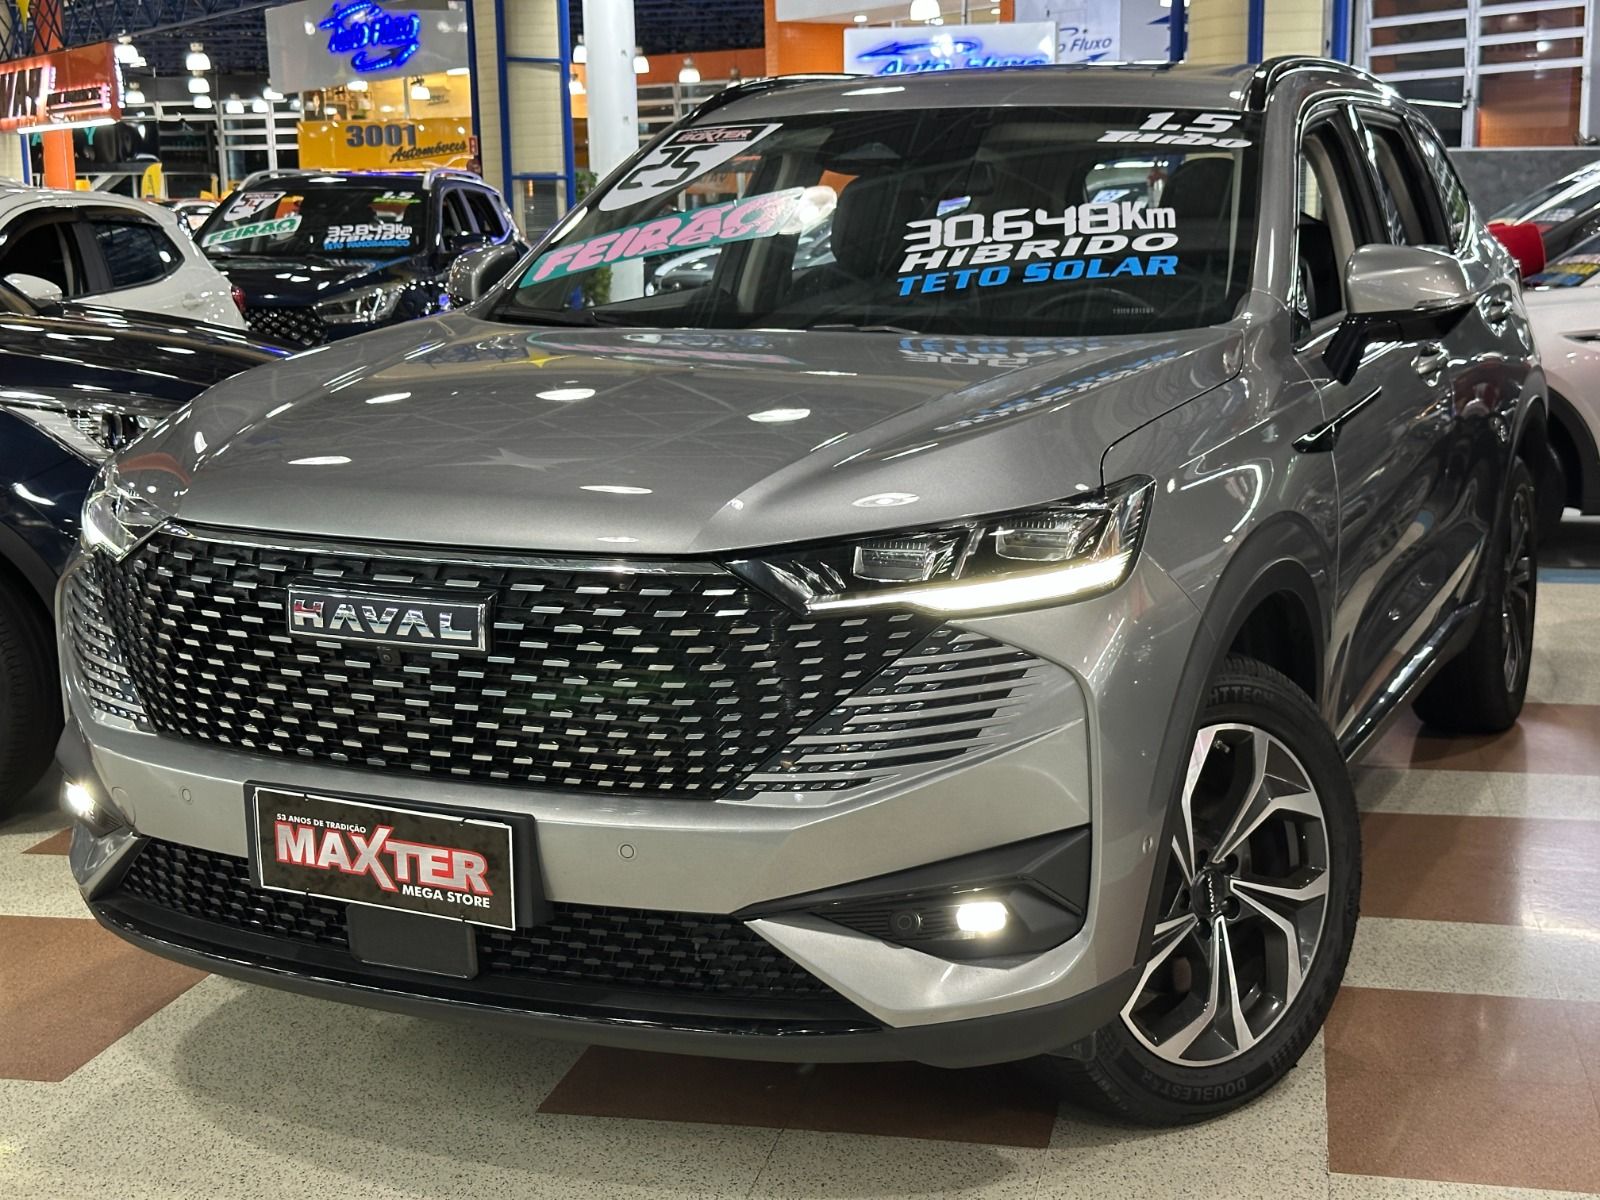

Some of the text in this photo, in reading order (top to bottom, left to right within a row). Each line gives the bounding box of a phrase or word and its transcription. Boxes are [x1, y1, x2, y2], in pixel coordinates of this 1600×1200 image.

[1070, 37, 1112, 52] Fluxo
[1139, 112, 1242, 133] 1.5
[346, 124, 416, 148] 3001
[1097, 130, 1252, 148] Turbo
[617, 144, 720, 190] 25
[229, 199, 265, 214] 24
[903, 200, 1176, 253] 30.648Km
[896, 255, 1179, 296] TETO SOLAR
[294, 599, 472, 640] HAVAL
[276, 813, 367, 834] 53 ANOS DE TRADIÇÃO
[275, 824, 493, 895] MAXTER
[402, 884, 490, 909] MEGA STORE
